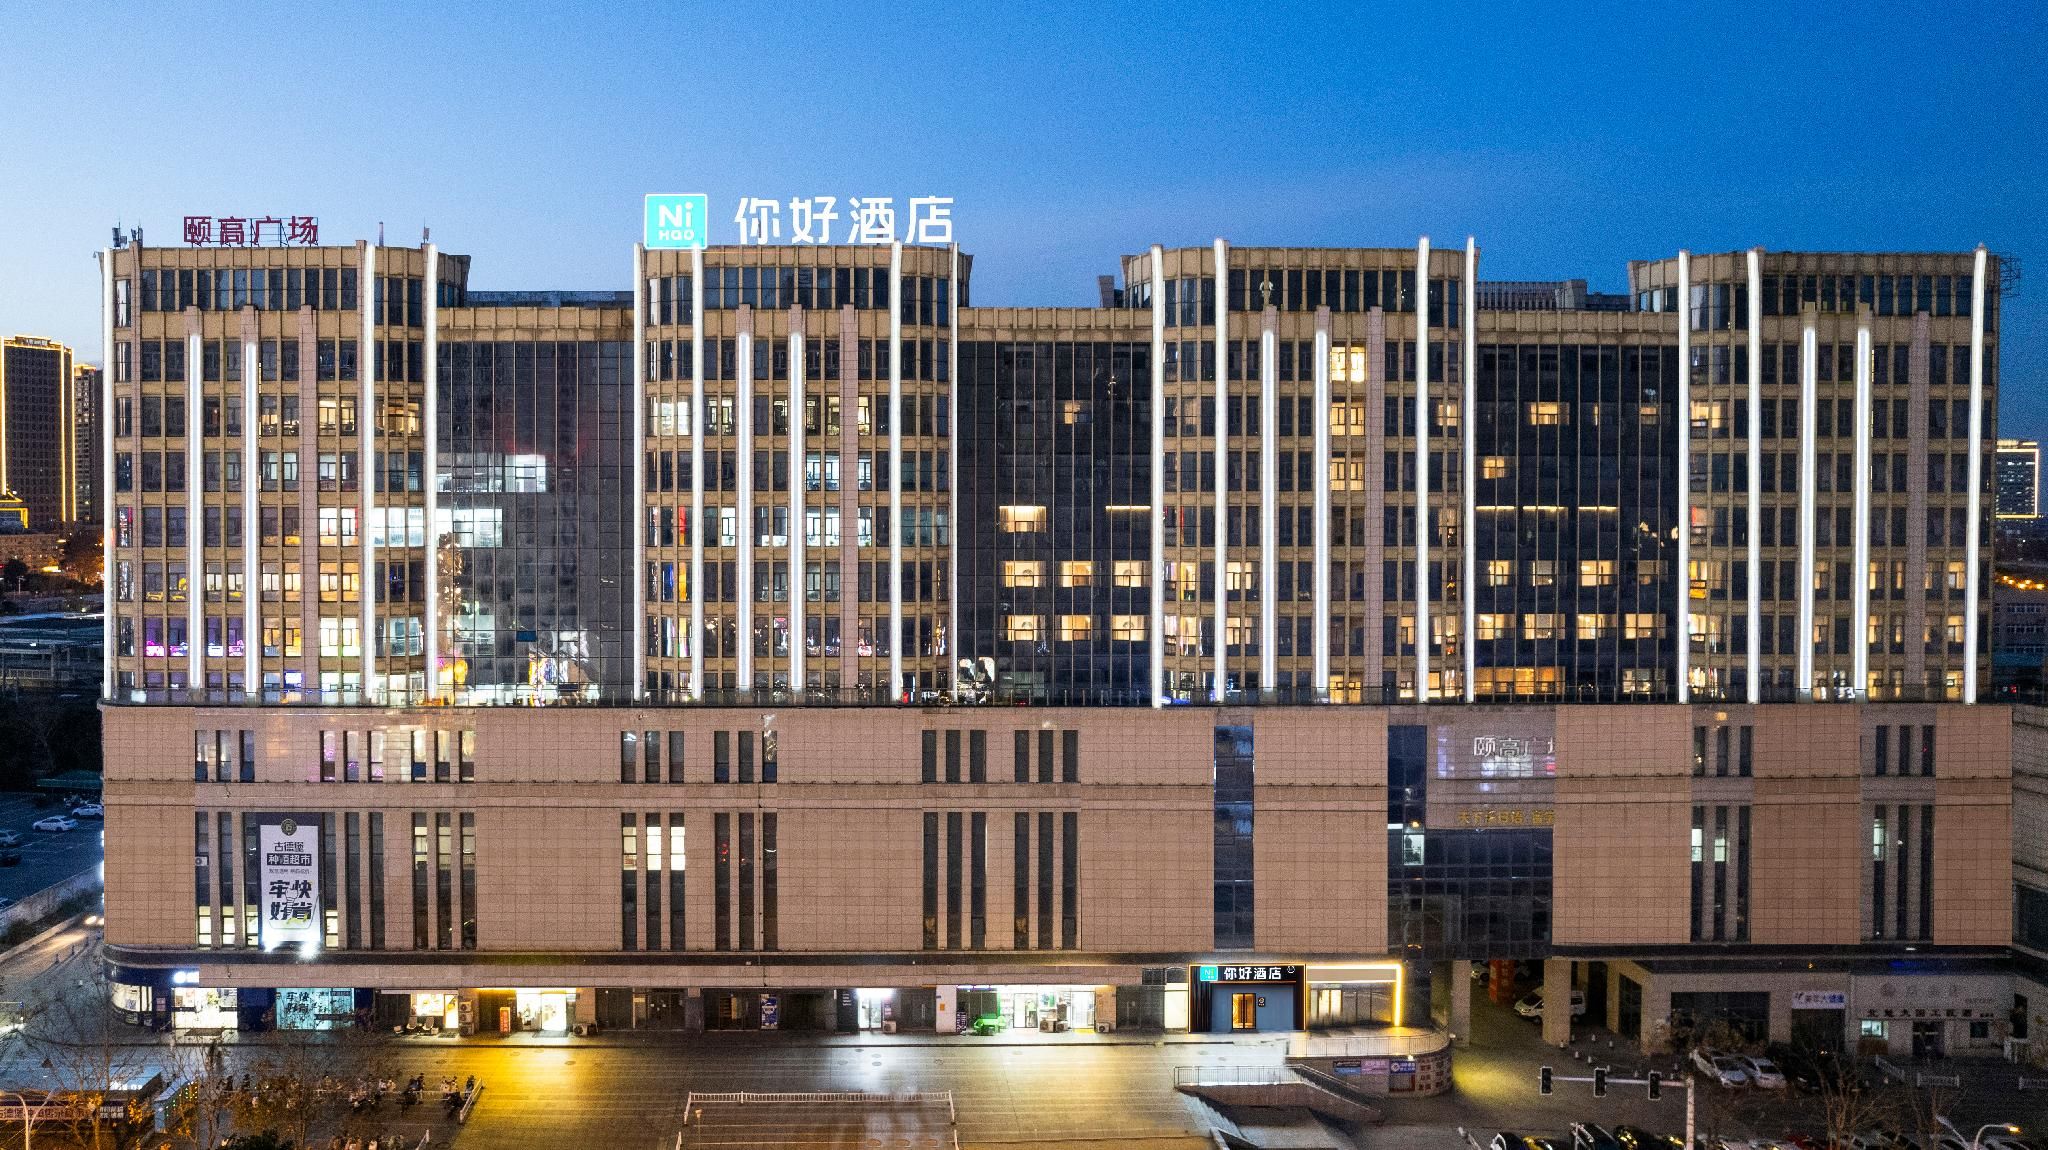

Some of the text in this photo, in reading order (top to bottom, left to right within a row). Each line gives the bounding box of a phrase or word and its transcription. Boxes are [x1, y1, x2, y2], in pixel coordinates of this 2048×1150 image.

[658, 201, 694, 228] Ni
[734, 196, 954, 245] 你好酒店
[184, 216, 318, 245] 颐高广场
[1224, 967, 1282, 981] 你好酒店
